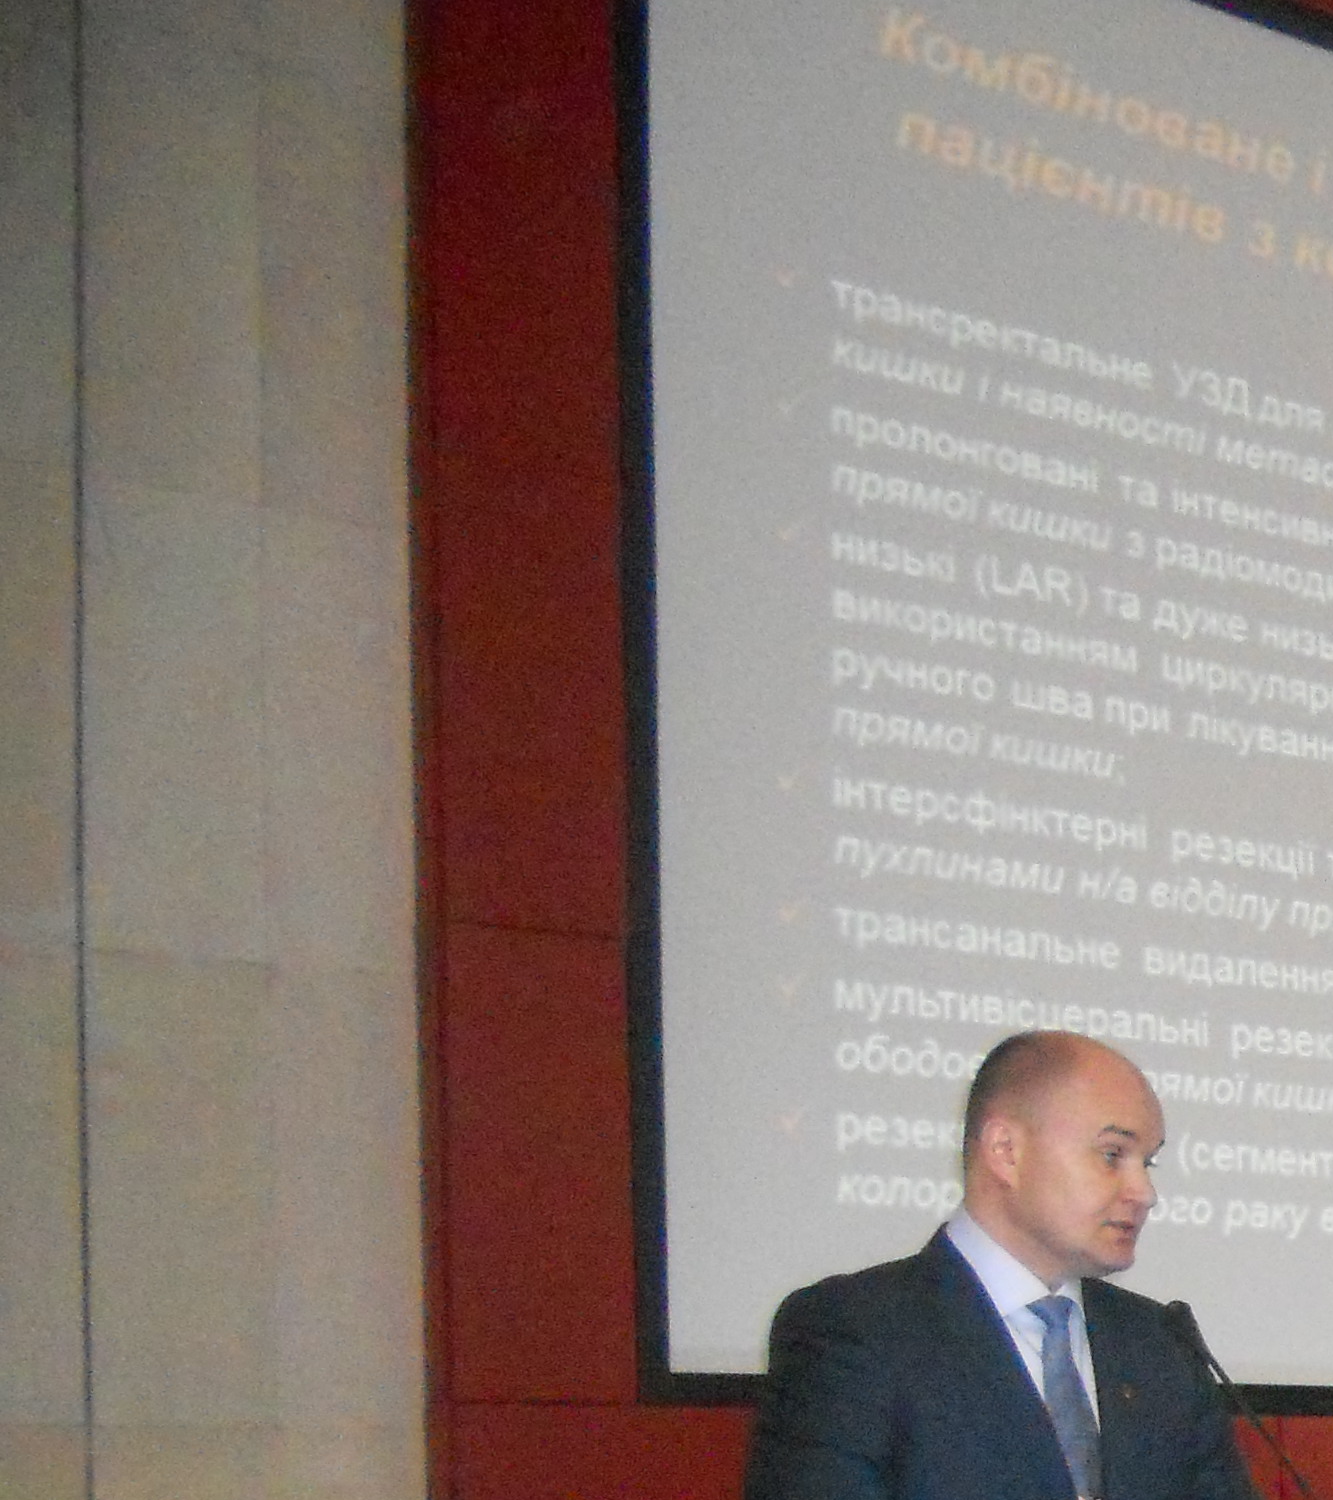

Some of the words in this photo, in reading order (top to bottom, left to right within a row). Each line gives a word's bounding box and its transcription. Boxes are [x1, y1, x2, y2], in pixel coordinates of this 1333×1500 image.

[878, 10, 1296, 182] Комбіноване
[1310, 155, 1327, 196] і
[898, 111, 1226, 244] пацієнтів
[1248, 223, 1277, 261] з
[831, 338, 965, 395] кишки
[977, 372, 990, 402] і
[1000, 381, 1206, 456] наявності
[1173, 361, 1250, 421] УЗД
[1257, 394, 1325, 433] для
[831, 405, 1100, 493] пролонговані
[1117, 474, 1159, 509] та
[831, 463, 983, 521] прямої
[987, 500, 1113, 552] кишки
[1125, 530, 1146, 559] з
[831, 532, 956, 584] низькі
[973, 554, 1089, 618] (LAR)
[1100, 584, 1142, 622] та
[1152, 597, 1249, 642] дуже
[831, 588, 1138, 674] використанням
[831, 647, 996, 702] ручного
[1010, 680, 1094, 720] шва
[1104, 694, 1171, 736] при
[831, 706, 983, 756] прямої
[832, 767, 1148, 851] інтерсфінктерні
[1170, 827, 1316, 881] резекції
[834, 834, 1065, 895] пухлинами
[1077, 866, 1138, 904] н/а
[1149, 876, 1280, 932] відділу
[832, 904, 1121, 970] трансанальне
[834, 978, 1210, 1047] мультивісцеральні
[836, 1033, 985, 1080] ободо
[1147, 1066, 1249, 1105] рямої
[836, 1111, 962, 1152] резек
[1222, 1196, 1310, 1240] раку
